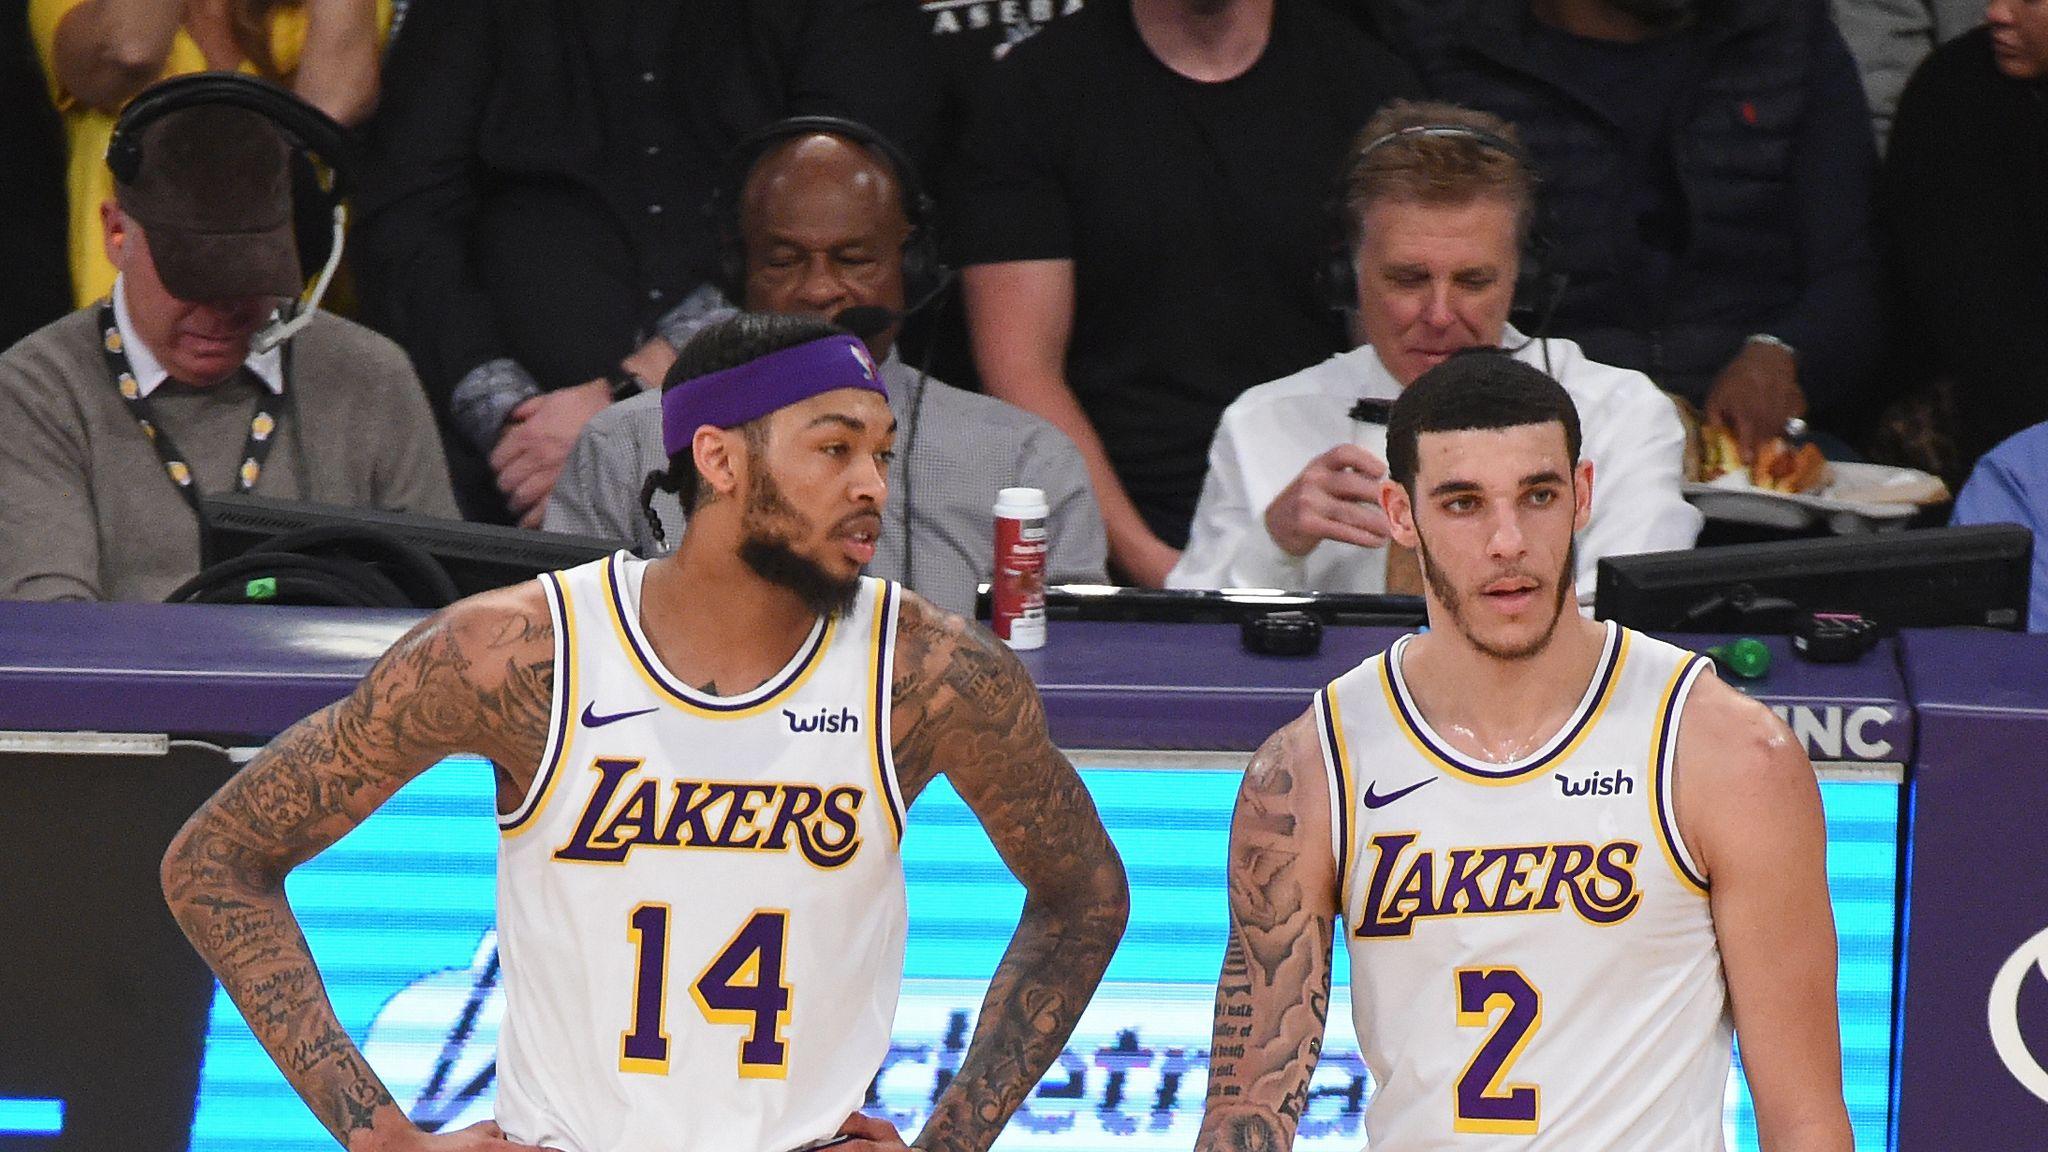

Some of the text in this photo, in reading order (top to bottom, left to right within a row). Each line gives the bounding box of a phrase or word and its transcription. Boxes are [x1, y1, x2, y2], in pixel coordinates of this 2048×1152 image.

[782, 708, 859, 734] wish
[1772, 705, 1893, 759] NC
[551, 754, 867, 870] LAKERS
[1554, 769, 1634, 797] wish
[1353, 829, 1644, 941] LAKERS
[618, 900, 795, 1081] 14
[1452, 964, 1543, 1136] 2
